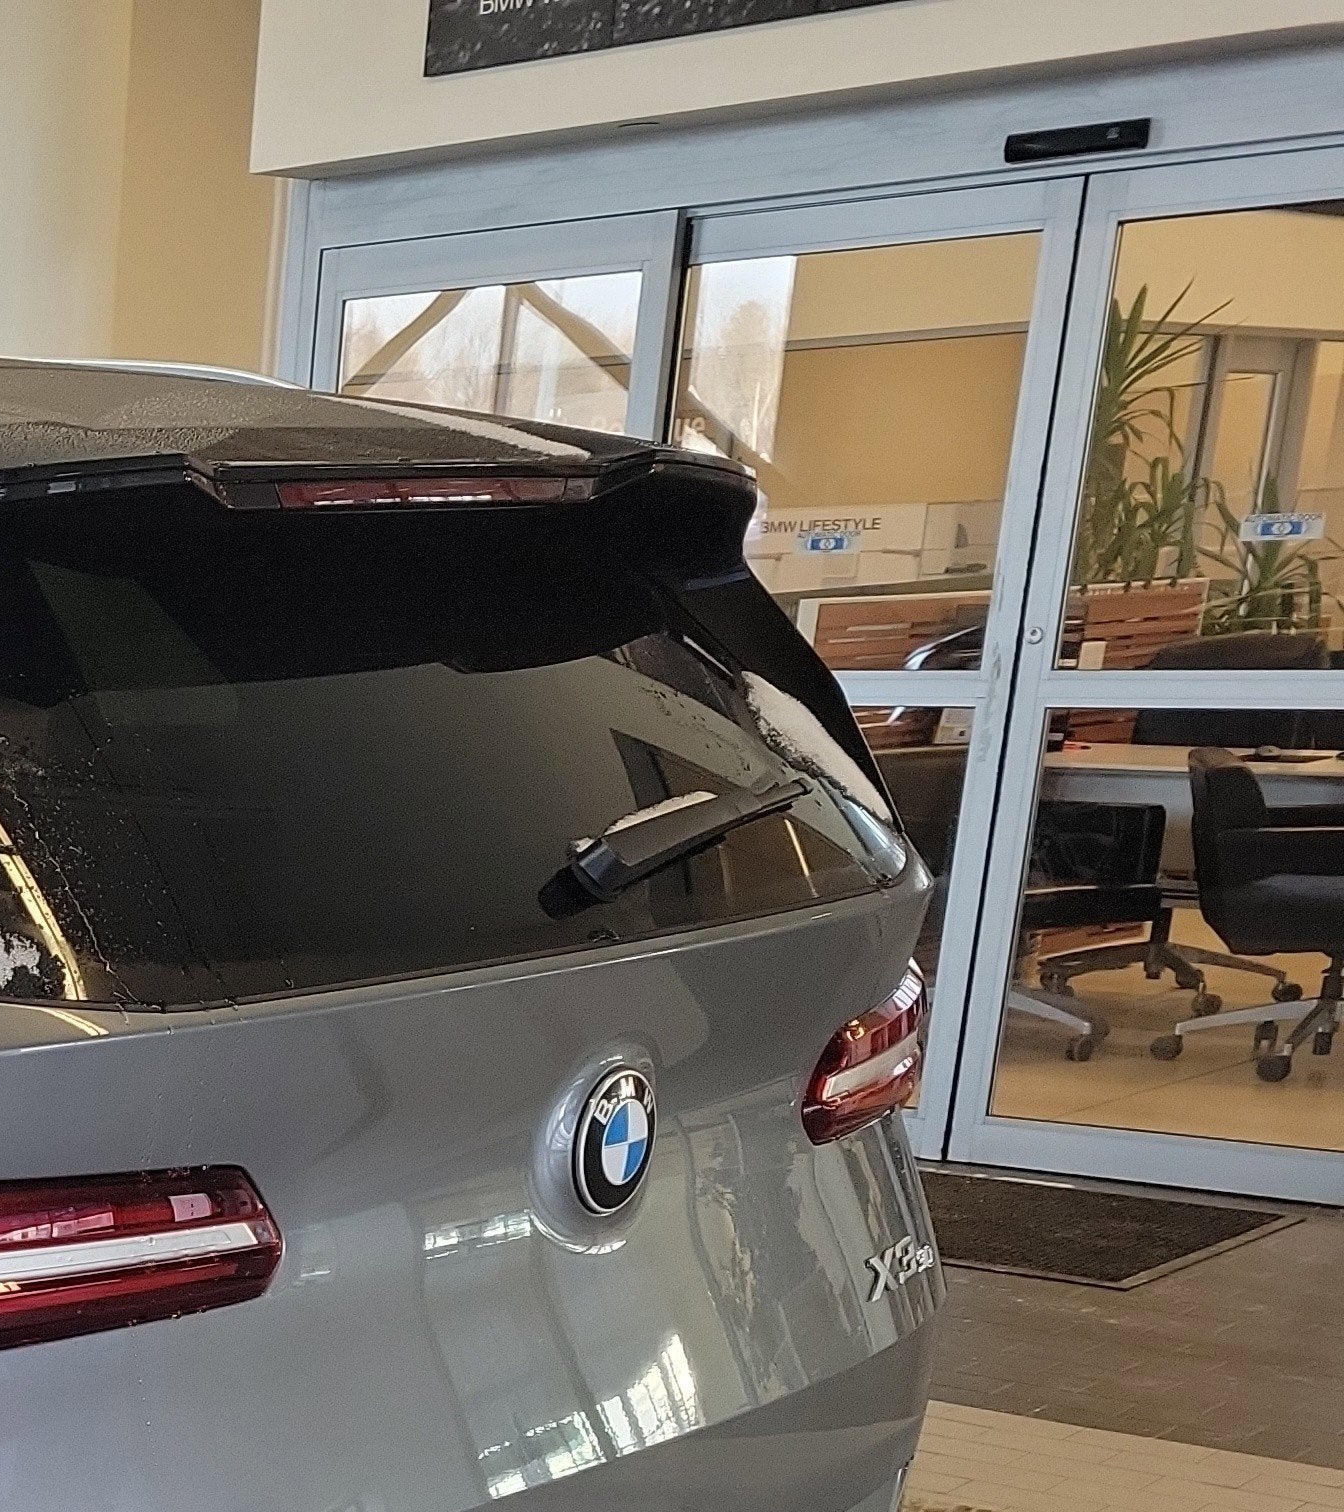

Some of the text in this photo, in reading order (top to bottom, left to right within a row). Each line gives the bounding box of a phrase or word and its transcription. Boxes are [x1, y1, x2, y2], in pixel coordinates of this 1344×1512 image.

[761, 518, 882, 533] BMW LIFESTYLE
[593, 1076, 654, 1126] BMW
